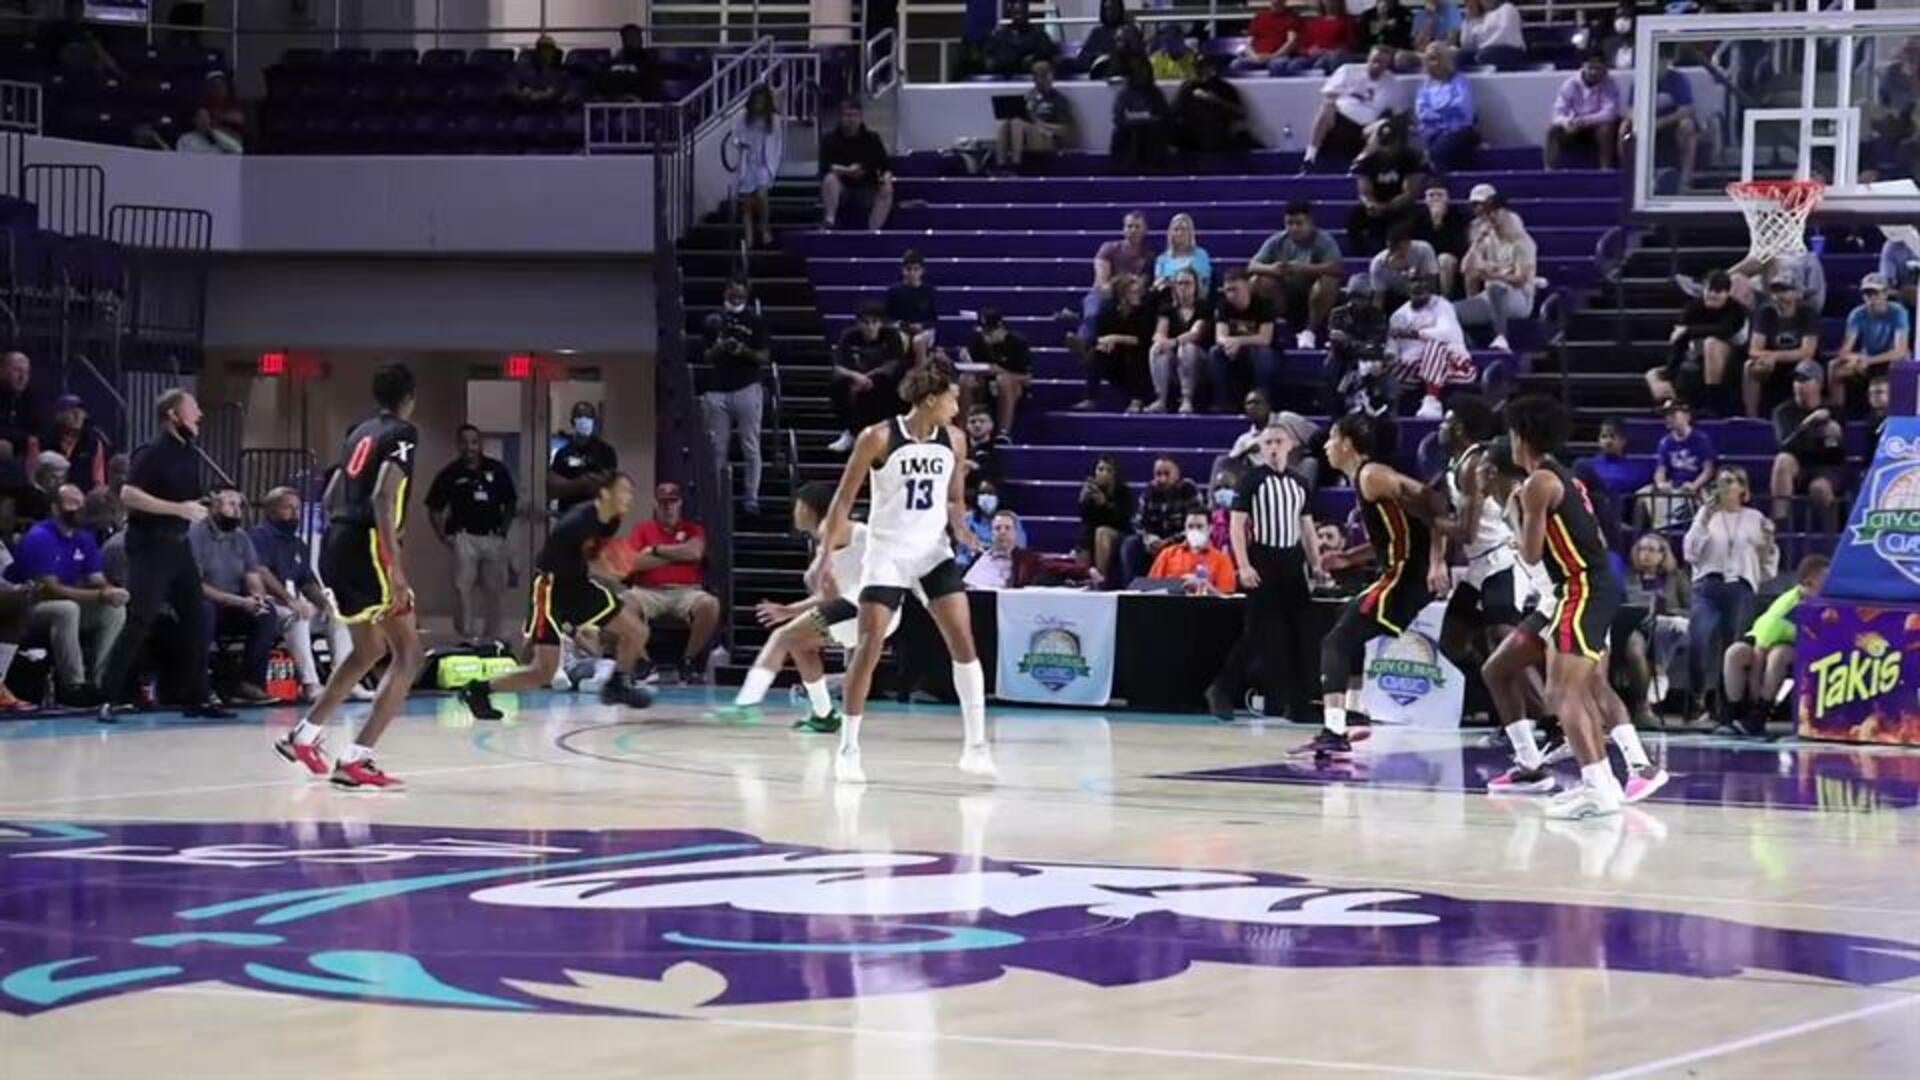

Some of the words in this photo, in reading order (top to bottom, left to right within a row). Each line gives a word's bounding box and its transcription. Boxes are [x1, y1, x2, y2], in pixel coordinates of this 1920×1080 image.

[346, 436, 372, 476] 0
[905, 478, 933, 510] 13
[1869, 510, 1908, 529] CITY
[1809, 640, 1902, 718] Takis
